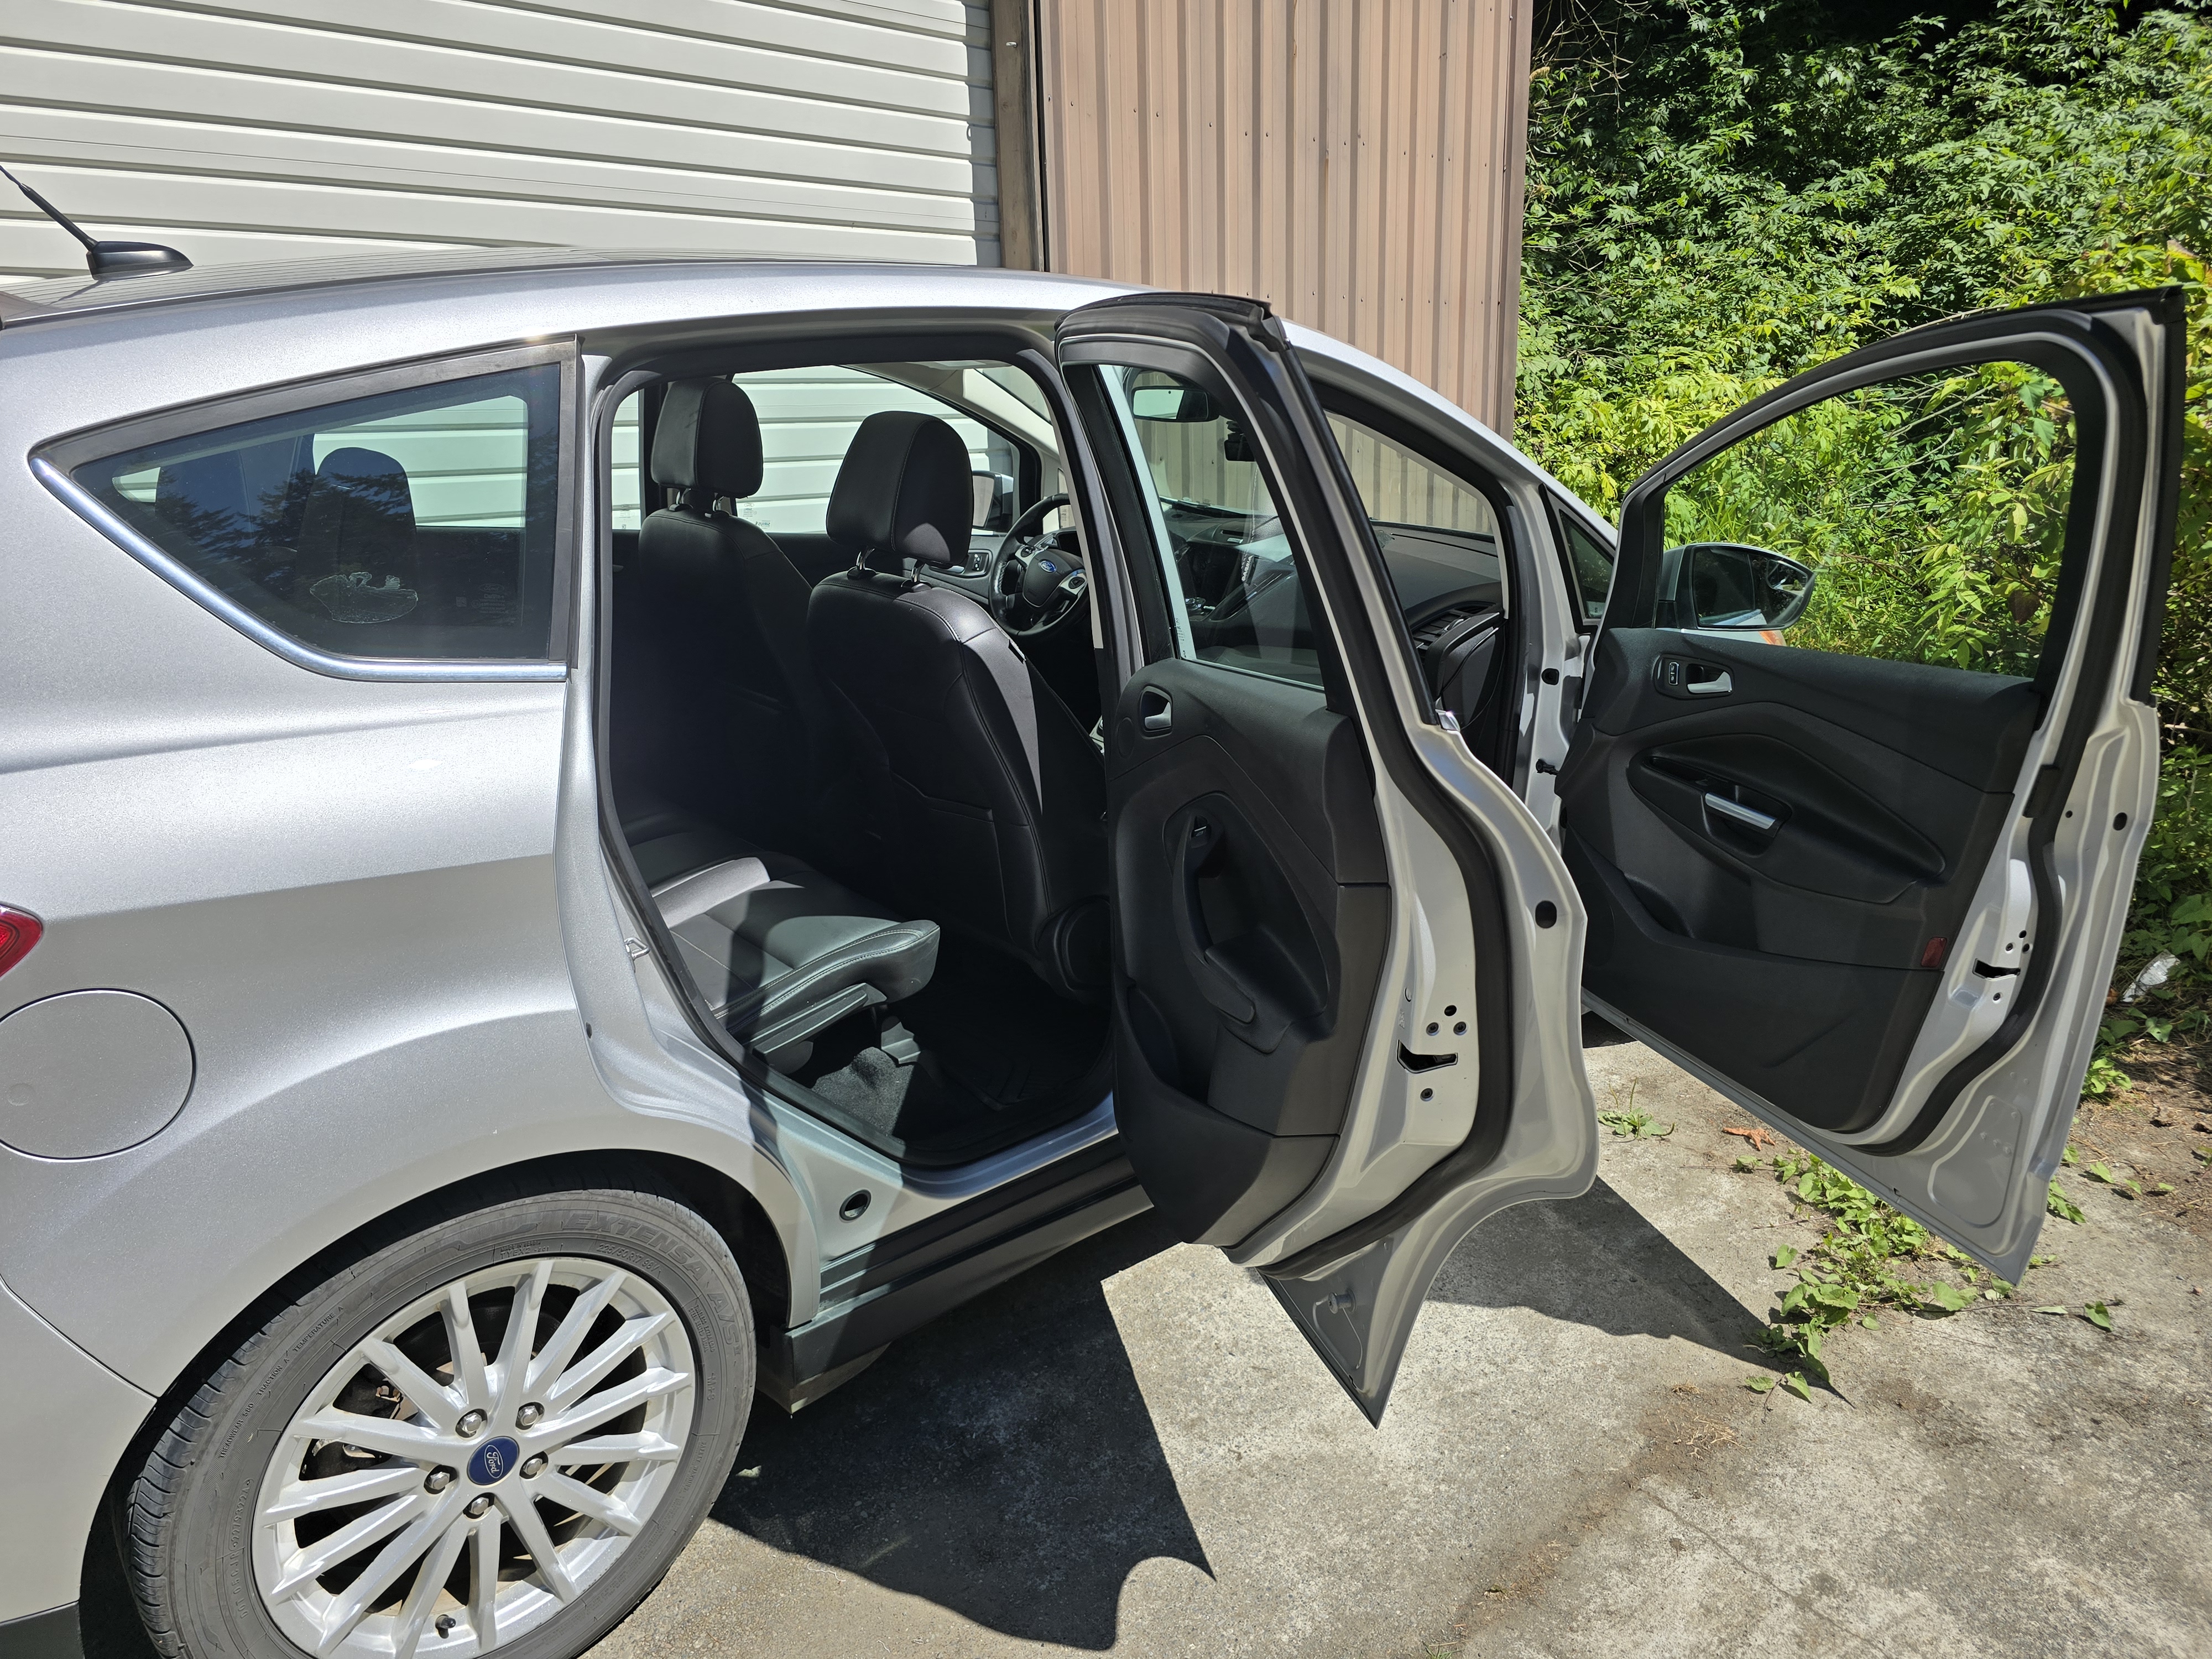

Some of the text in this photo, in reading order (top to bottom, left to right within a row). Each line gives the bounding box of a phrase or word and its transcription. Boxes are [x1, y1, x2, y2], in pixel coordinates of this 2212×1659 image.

[562, 1213, 708, 1281] EXTENSA
[218, 1420, 243, 1458] TREADWEAR
[257, 1365, 283, 1395] TRACTION
[293, 1312, 336, 1353] TEMPERATURE
[487, 1451, 500, 1474] Ford
[236, 1598, 248, 1619] DOT
